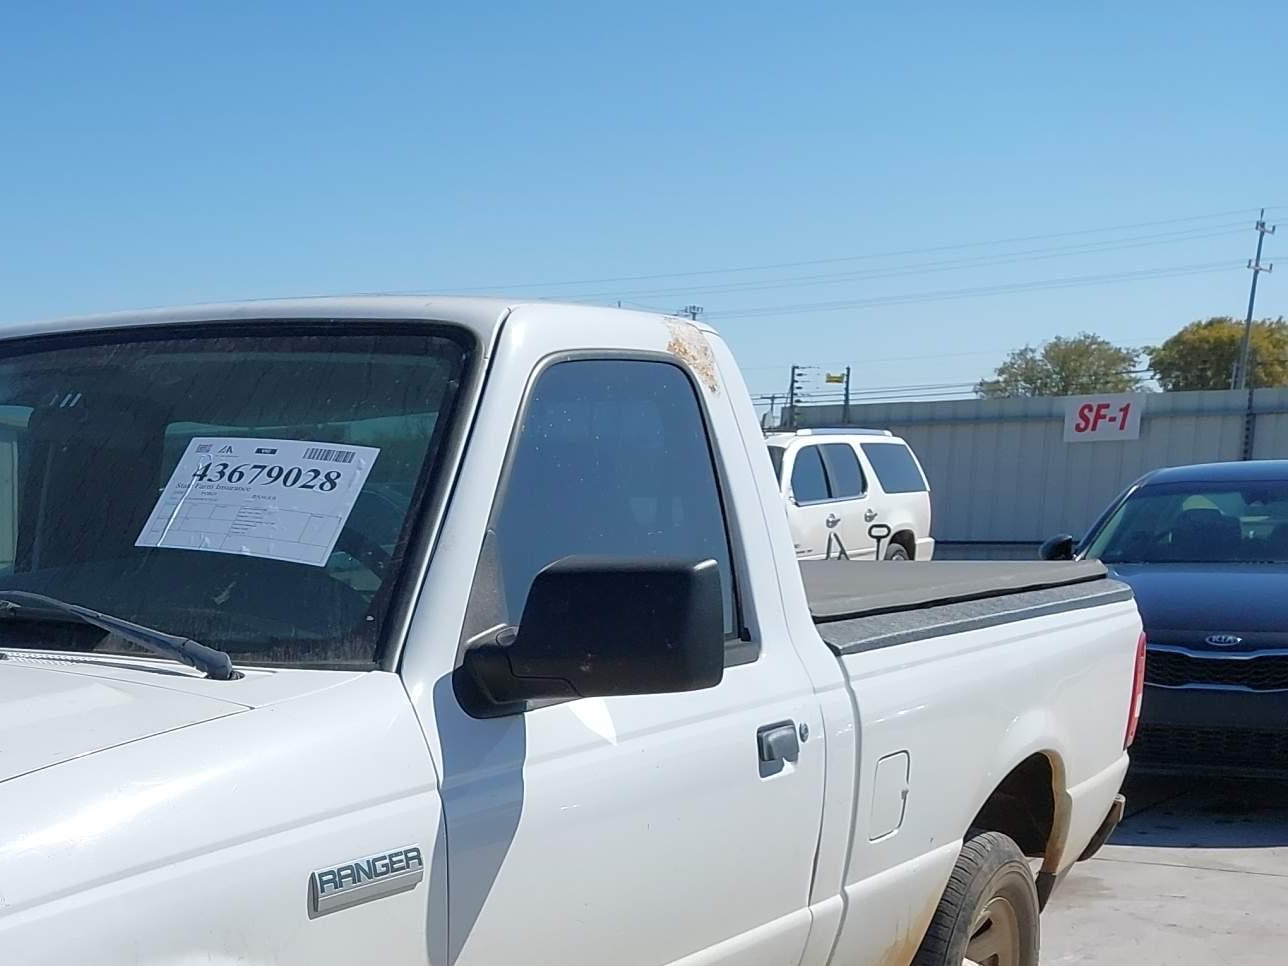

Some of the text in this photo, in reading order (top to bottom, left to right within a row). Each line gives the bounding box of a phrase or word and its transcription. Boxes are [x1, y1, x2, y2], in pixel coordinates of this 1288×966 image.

[1075, 403, 1130, 432] SF-1
[192, 462, 342, 492] 43679028
[318, 847, 423, 894] RANGER
